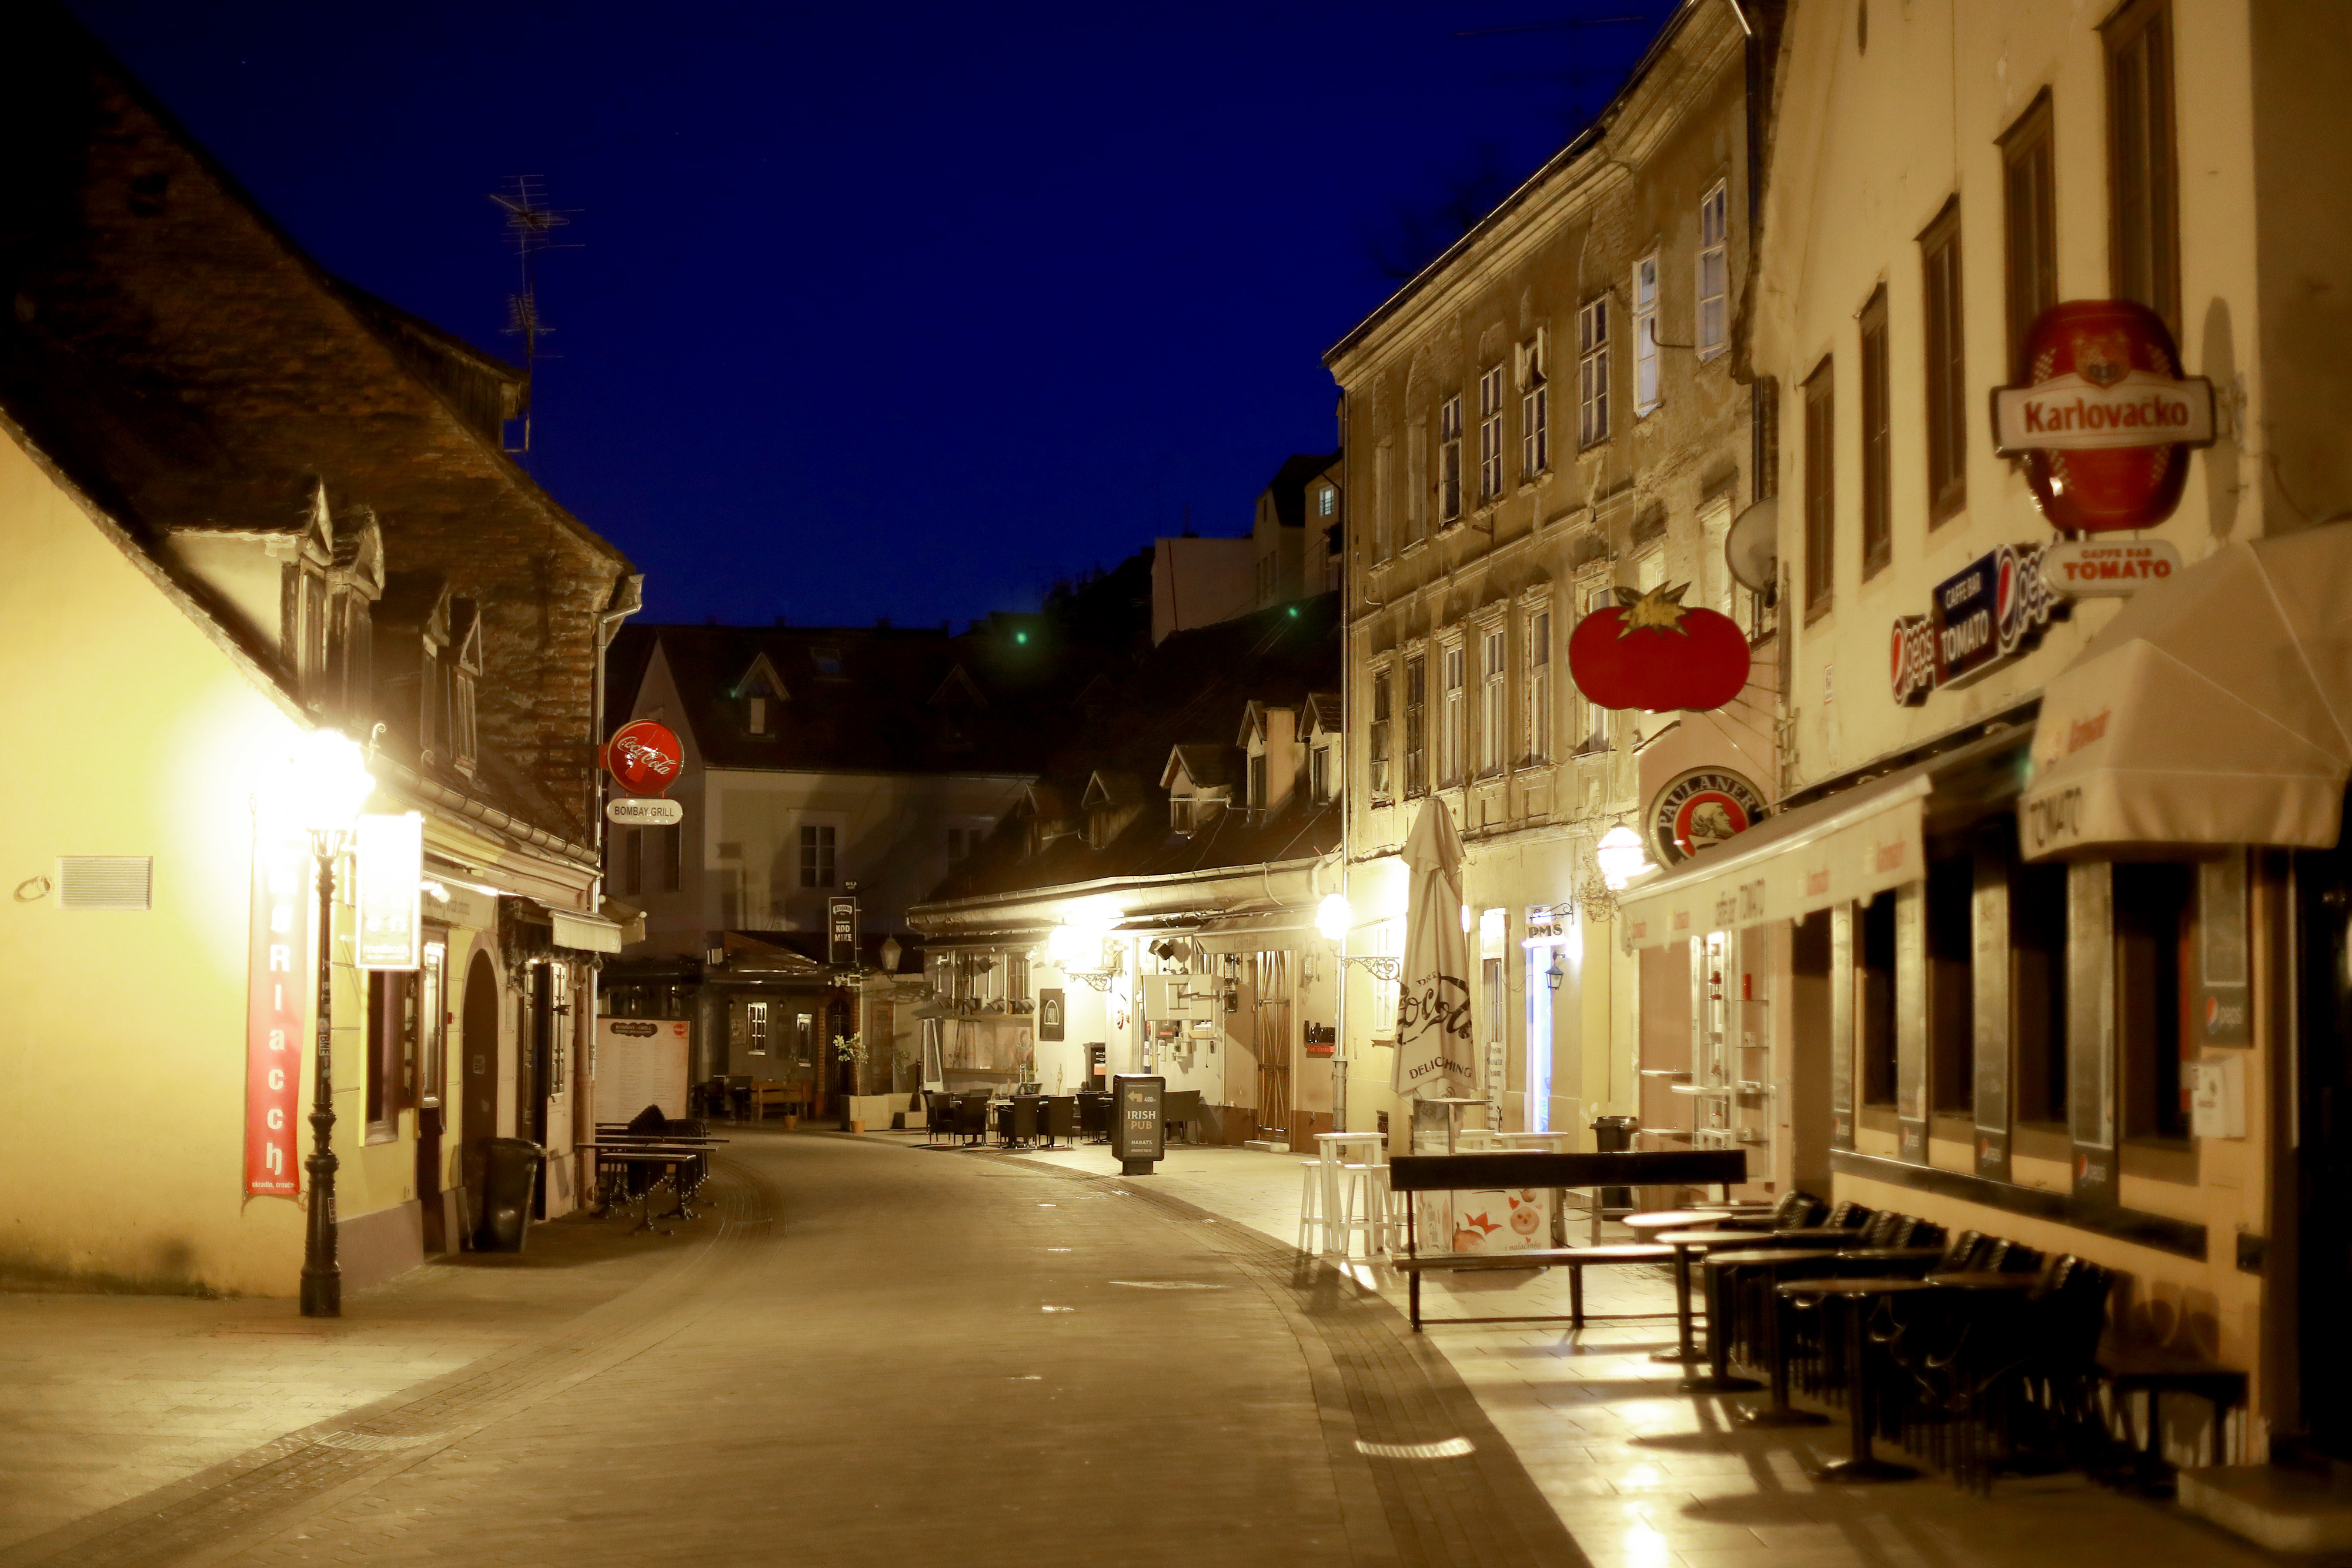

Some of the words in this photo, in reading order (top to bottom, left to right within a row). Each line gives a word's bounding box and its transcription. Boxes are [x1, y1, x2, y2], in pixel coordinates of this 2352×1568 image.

[2126, 547, 2152, 558] BAR
[2063, 559, 2172, 581] TOMATO
[1945, 579, 1967, 610] CAFFE
[1966, 570, 1982, 598] BAR
[1940, 609, 1989, 665] TOMATO
[1658, 775, 1757, 828] PAULANER
[614, 806, 647, 816] BOMBAY
[651, 807, 674, 817] GRILL
[836, 925, 850, 933] KOD
[1528, 924, 1563, 938] PMS
[834, 934, 852, 942] MIKE
[1127, 1111, 1156, 1119] IRISH
[1131, 1121, 1152, 1129] PUB
